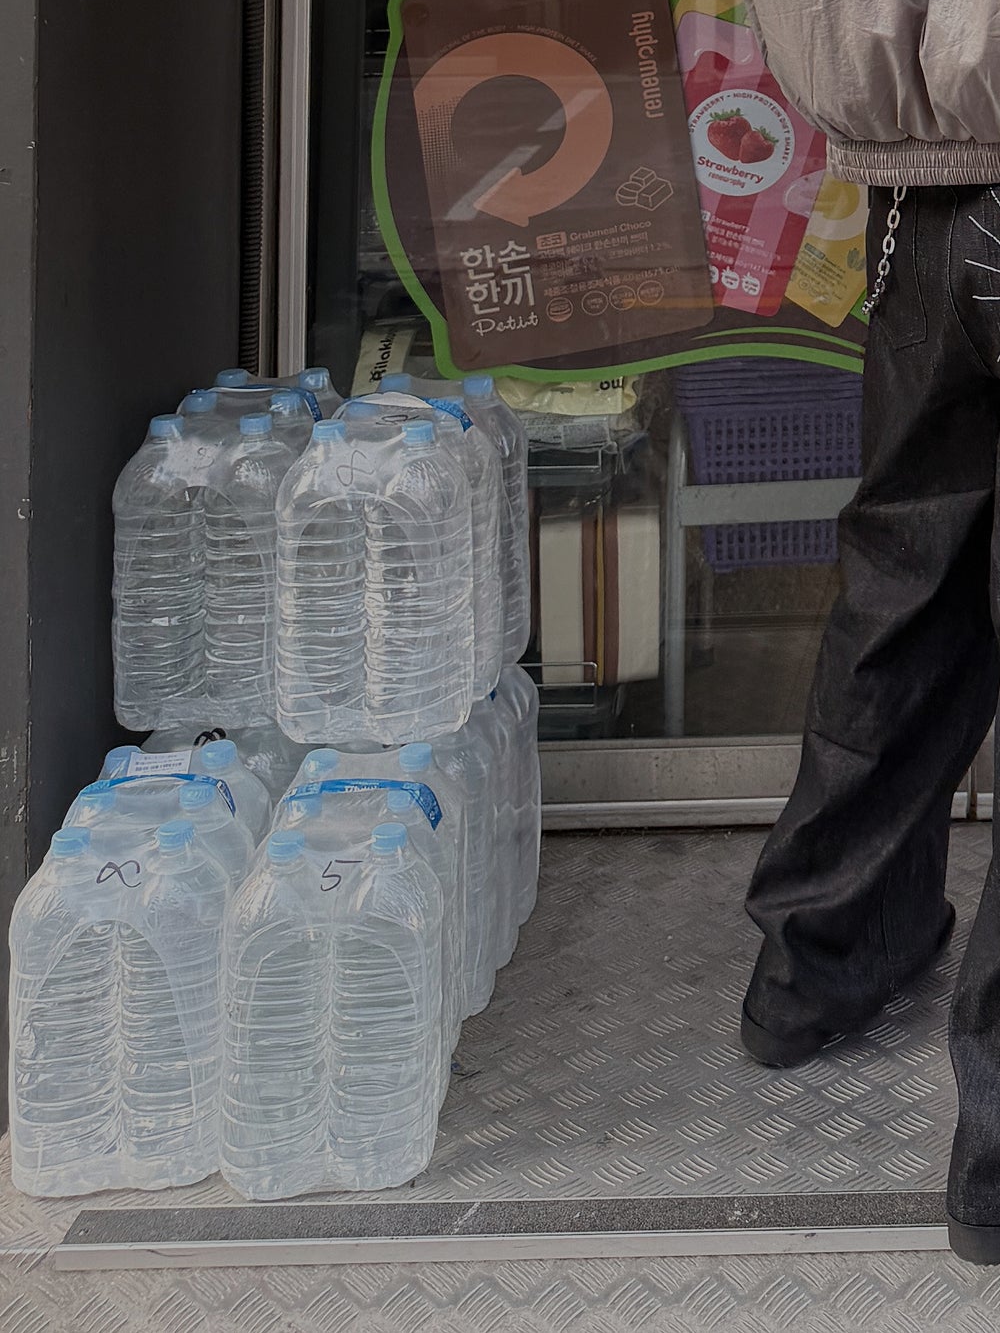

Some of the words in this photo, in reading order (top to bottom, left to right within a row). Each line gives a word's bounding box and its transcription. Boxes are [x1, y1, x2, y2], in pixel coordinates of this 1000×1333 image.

[688, 95, 725, 134] STRAWBERRY
[753, 94, 782, 121] PROTEIN
[697, 156, 764, 184] Strawberry
[460, 240, 531, 280] 한손
[466, 273, 535, 315] 한끼
[471, 311, 539, 337] Petit
